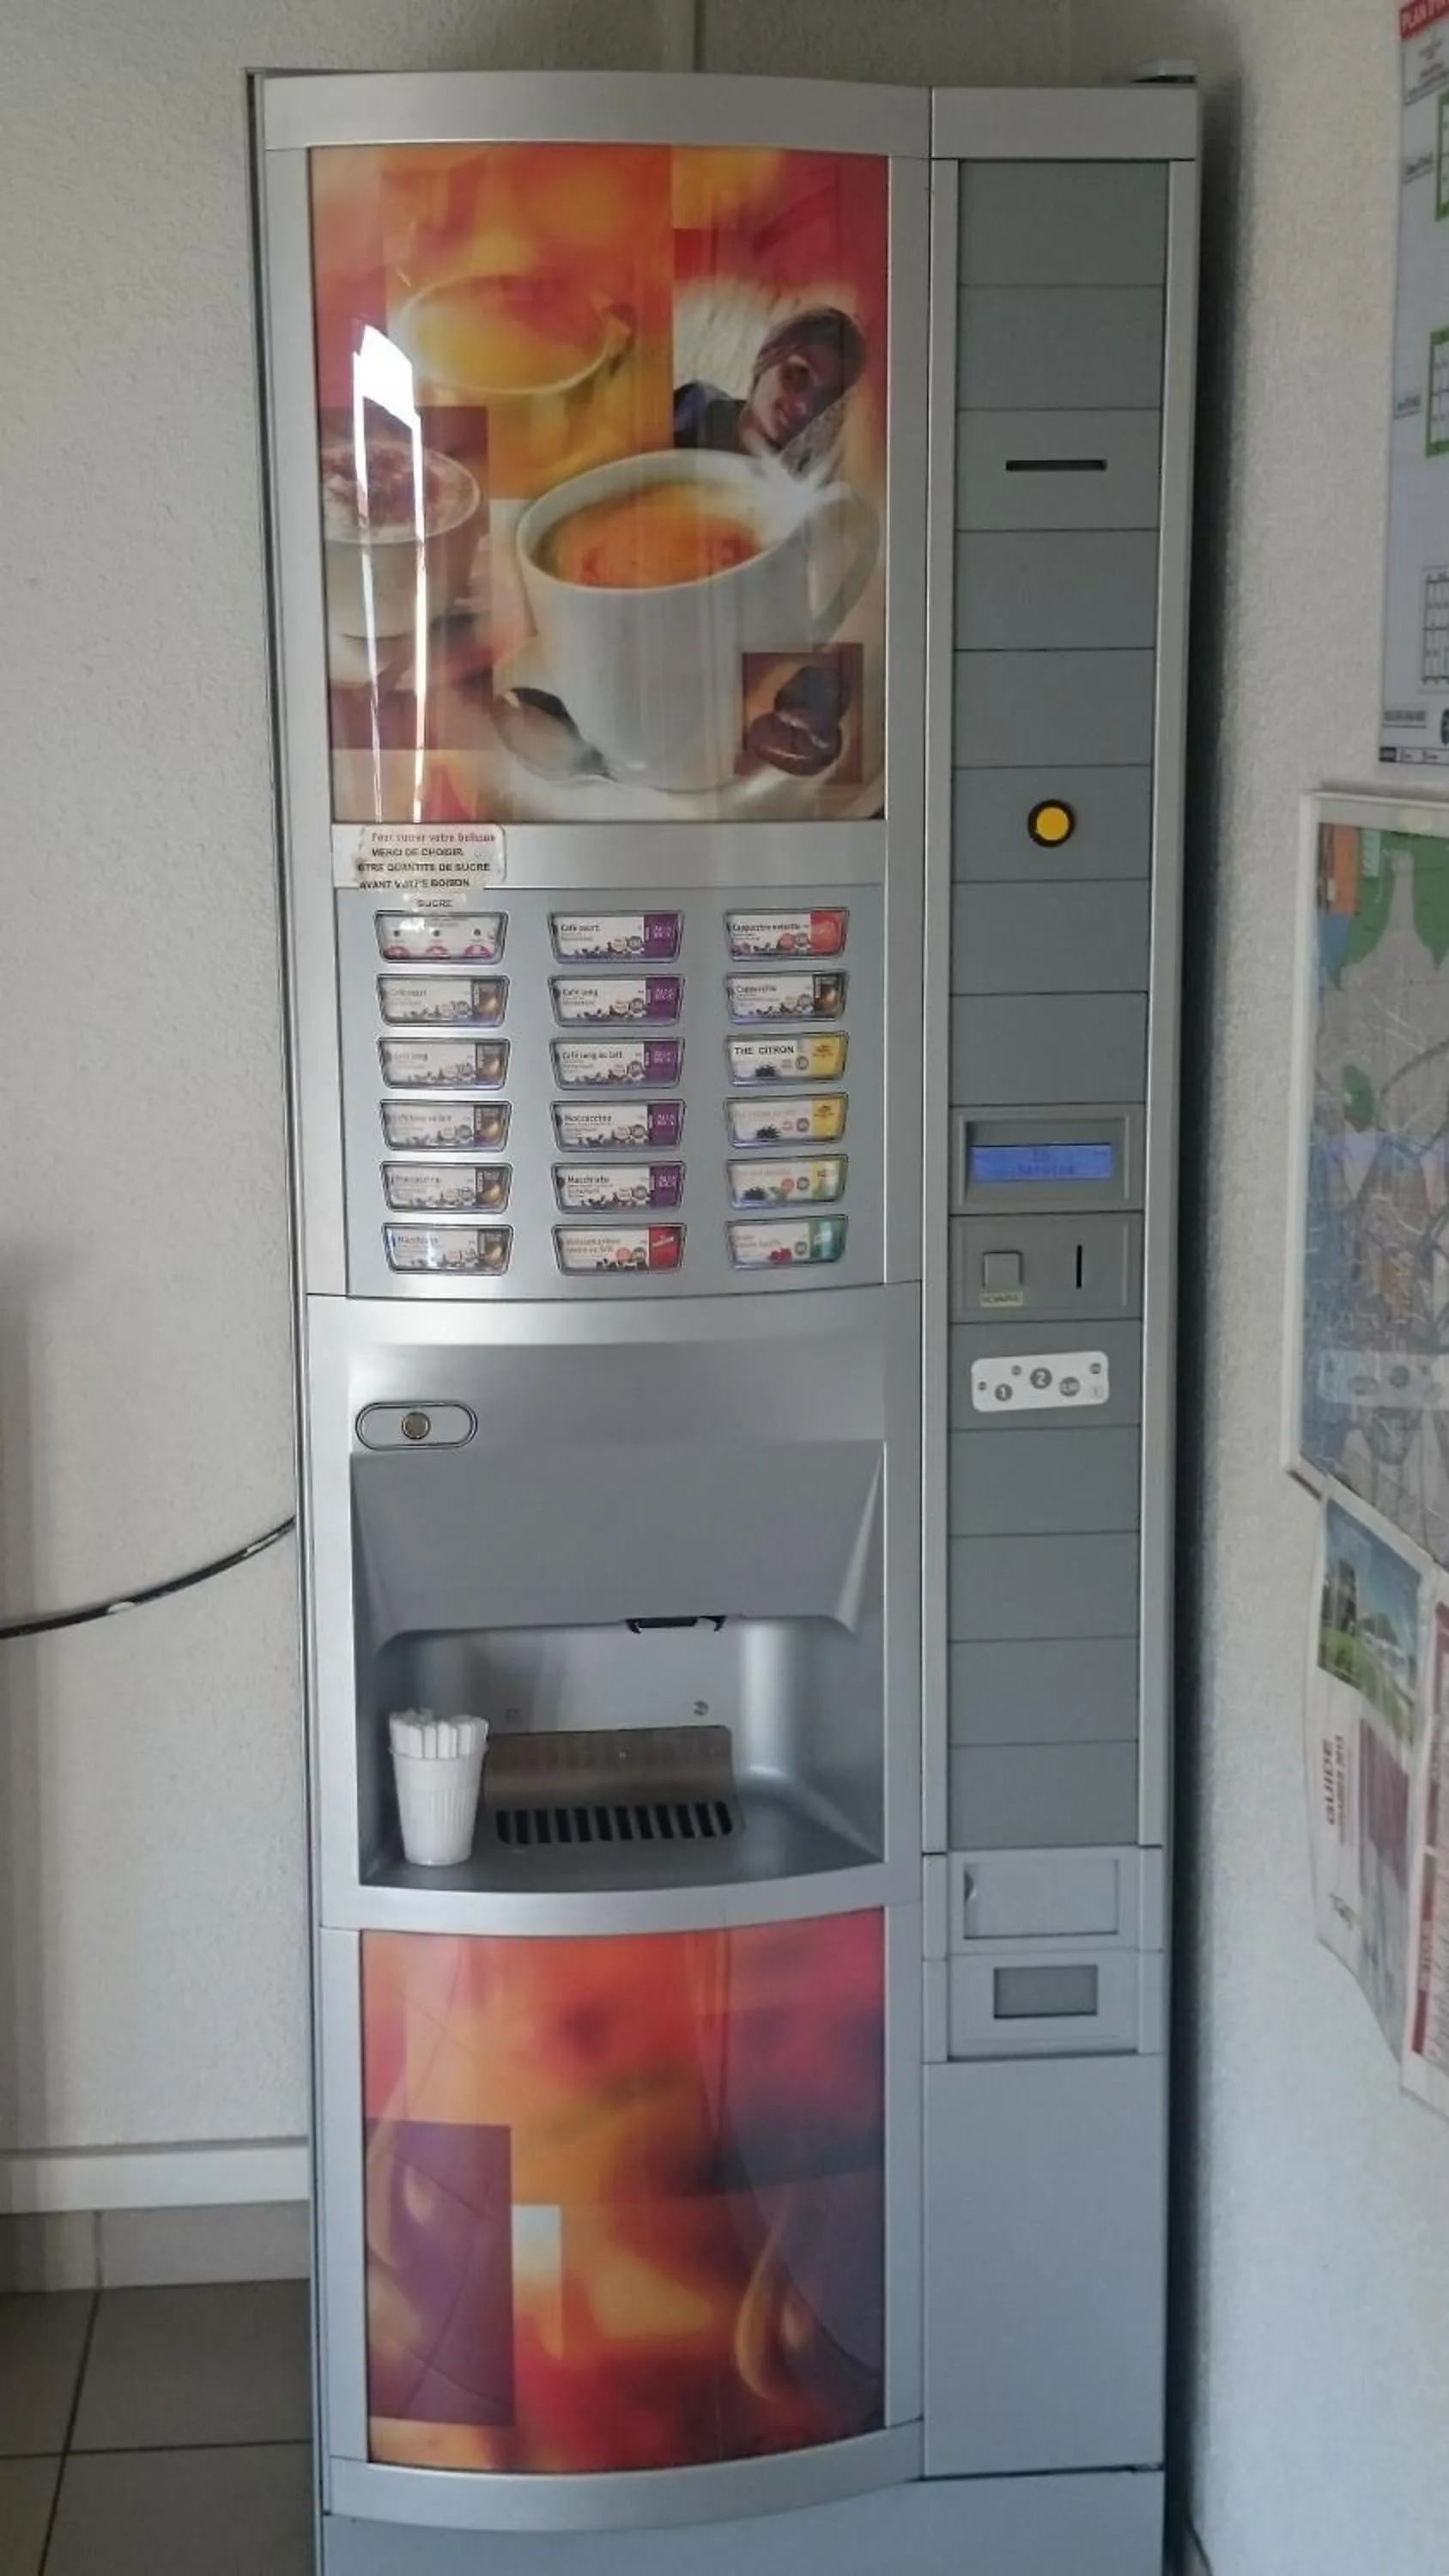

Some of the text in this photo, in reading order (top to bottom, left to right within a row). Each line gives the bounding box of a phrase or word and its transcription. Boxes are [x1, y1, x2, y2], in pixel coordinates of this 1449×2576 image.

[372, 848, 403, 857] MERCI
[404, 848, 419, 857] DE
[439, 862, 452, 872] DE
[454, 862, 491, 872] SUCRE
[416, 898, 454, 908] SUCRE
[734, 1045, 795, 1055] THE CITRON
